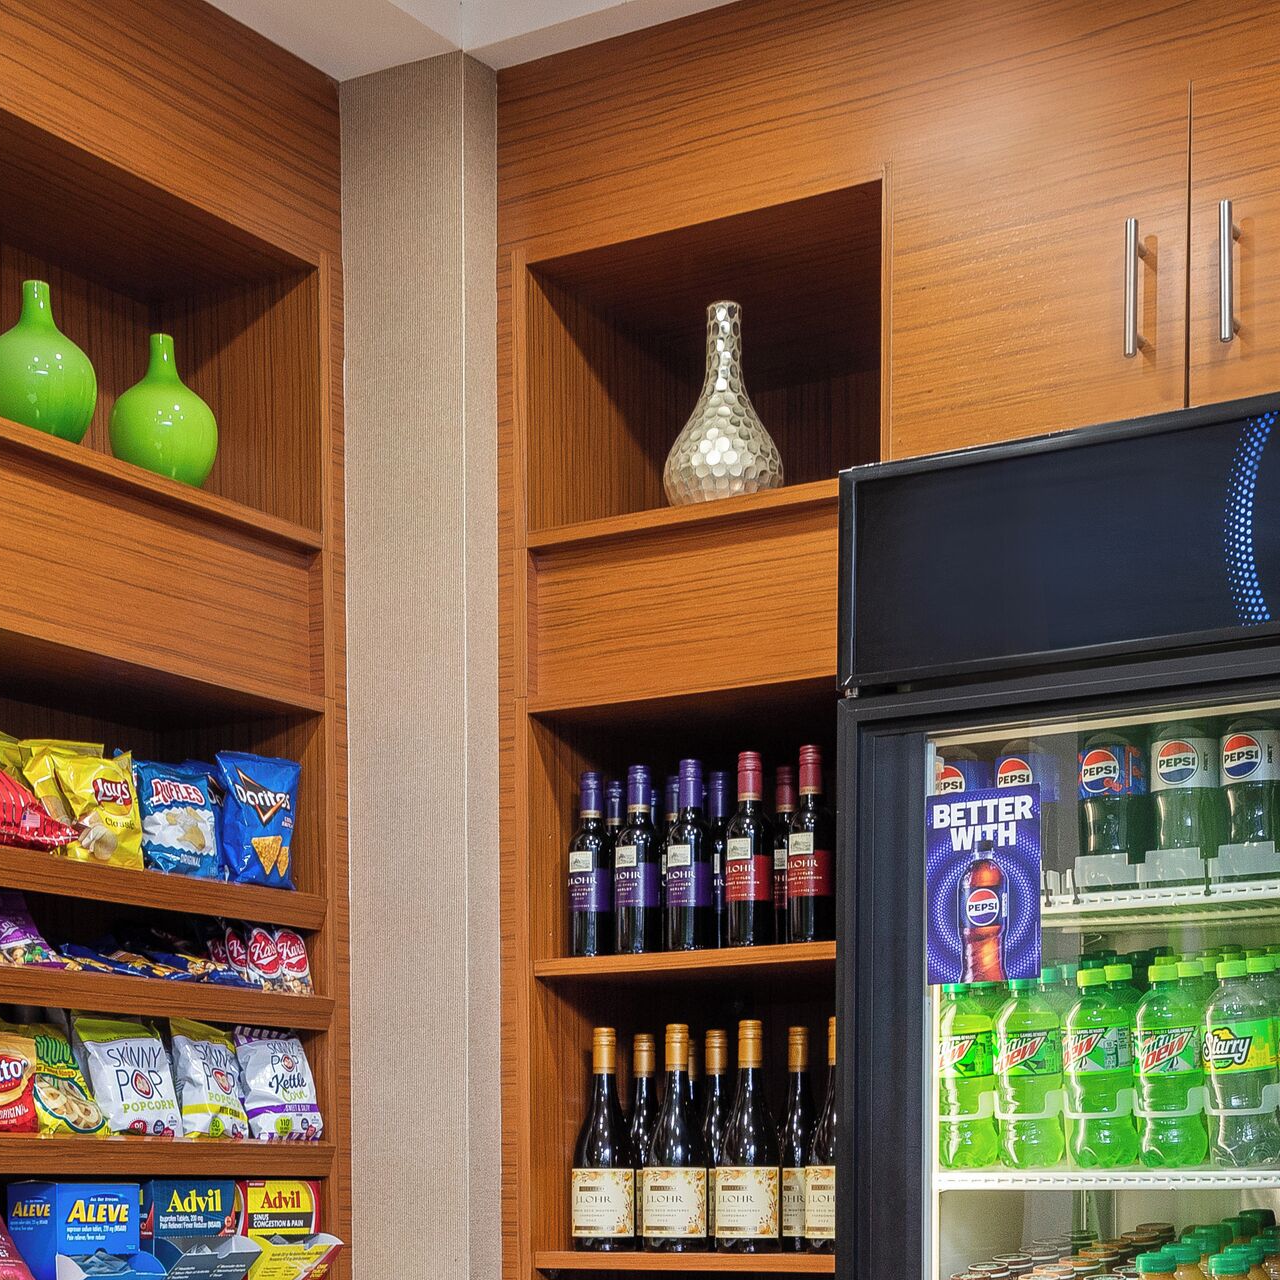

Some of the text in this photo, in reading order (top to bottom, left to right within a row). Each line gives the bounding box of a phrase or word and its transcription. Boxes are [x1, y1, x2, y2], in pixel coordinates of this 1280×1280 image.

[1158, 756, 1197, 771] PEPSI
[1224, 749, 1259, 766] PEPSI
[998, 774, 1030, 786] PEPSI
[1083, 766, 1117, 780] PEPSI
[94, 780, 129, 804] Lay's
[153, 780, 205, 804] RUFFLES
[235, 785, 290, 809] Doritos
[933, 795, 1033, 830] BETTER
[950, 822, 1016, 851] WITH
[180, 854, 201, 867] ORIGINAL
[968, 900, 998, 914] PEPSI
[1204, 1029, 1252, 1064] Starry
[270, 1073, 306, 1094] Kettle
[282, 1089, 308, 1103] Corn
[123, 1100, 174, 1114] POPCORN
[167, 1189, 222, 1213] Advil
[260, 1190, 301, 1208] Advil
[13, 1202, 51, 1217] ALEVE
[68, 1200, 130, 1223] ALEVE
